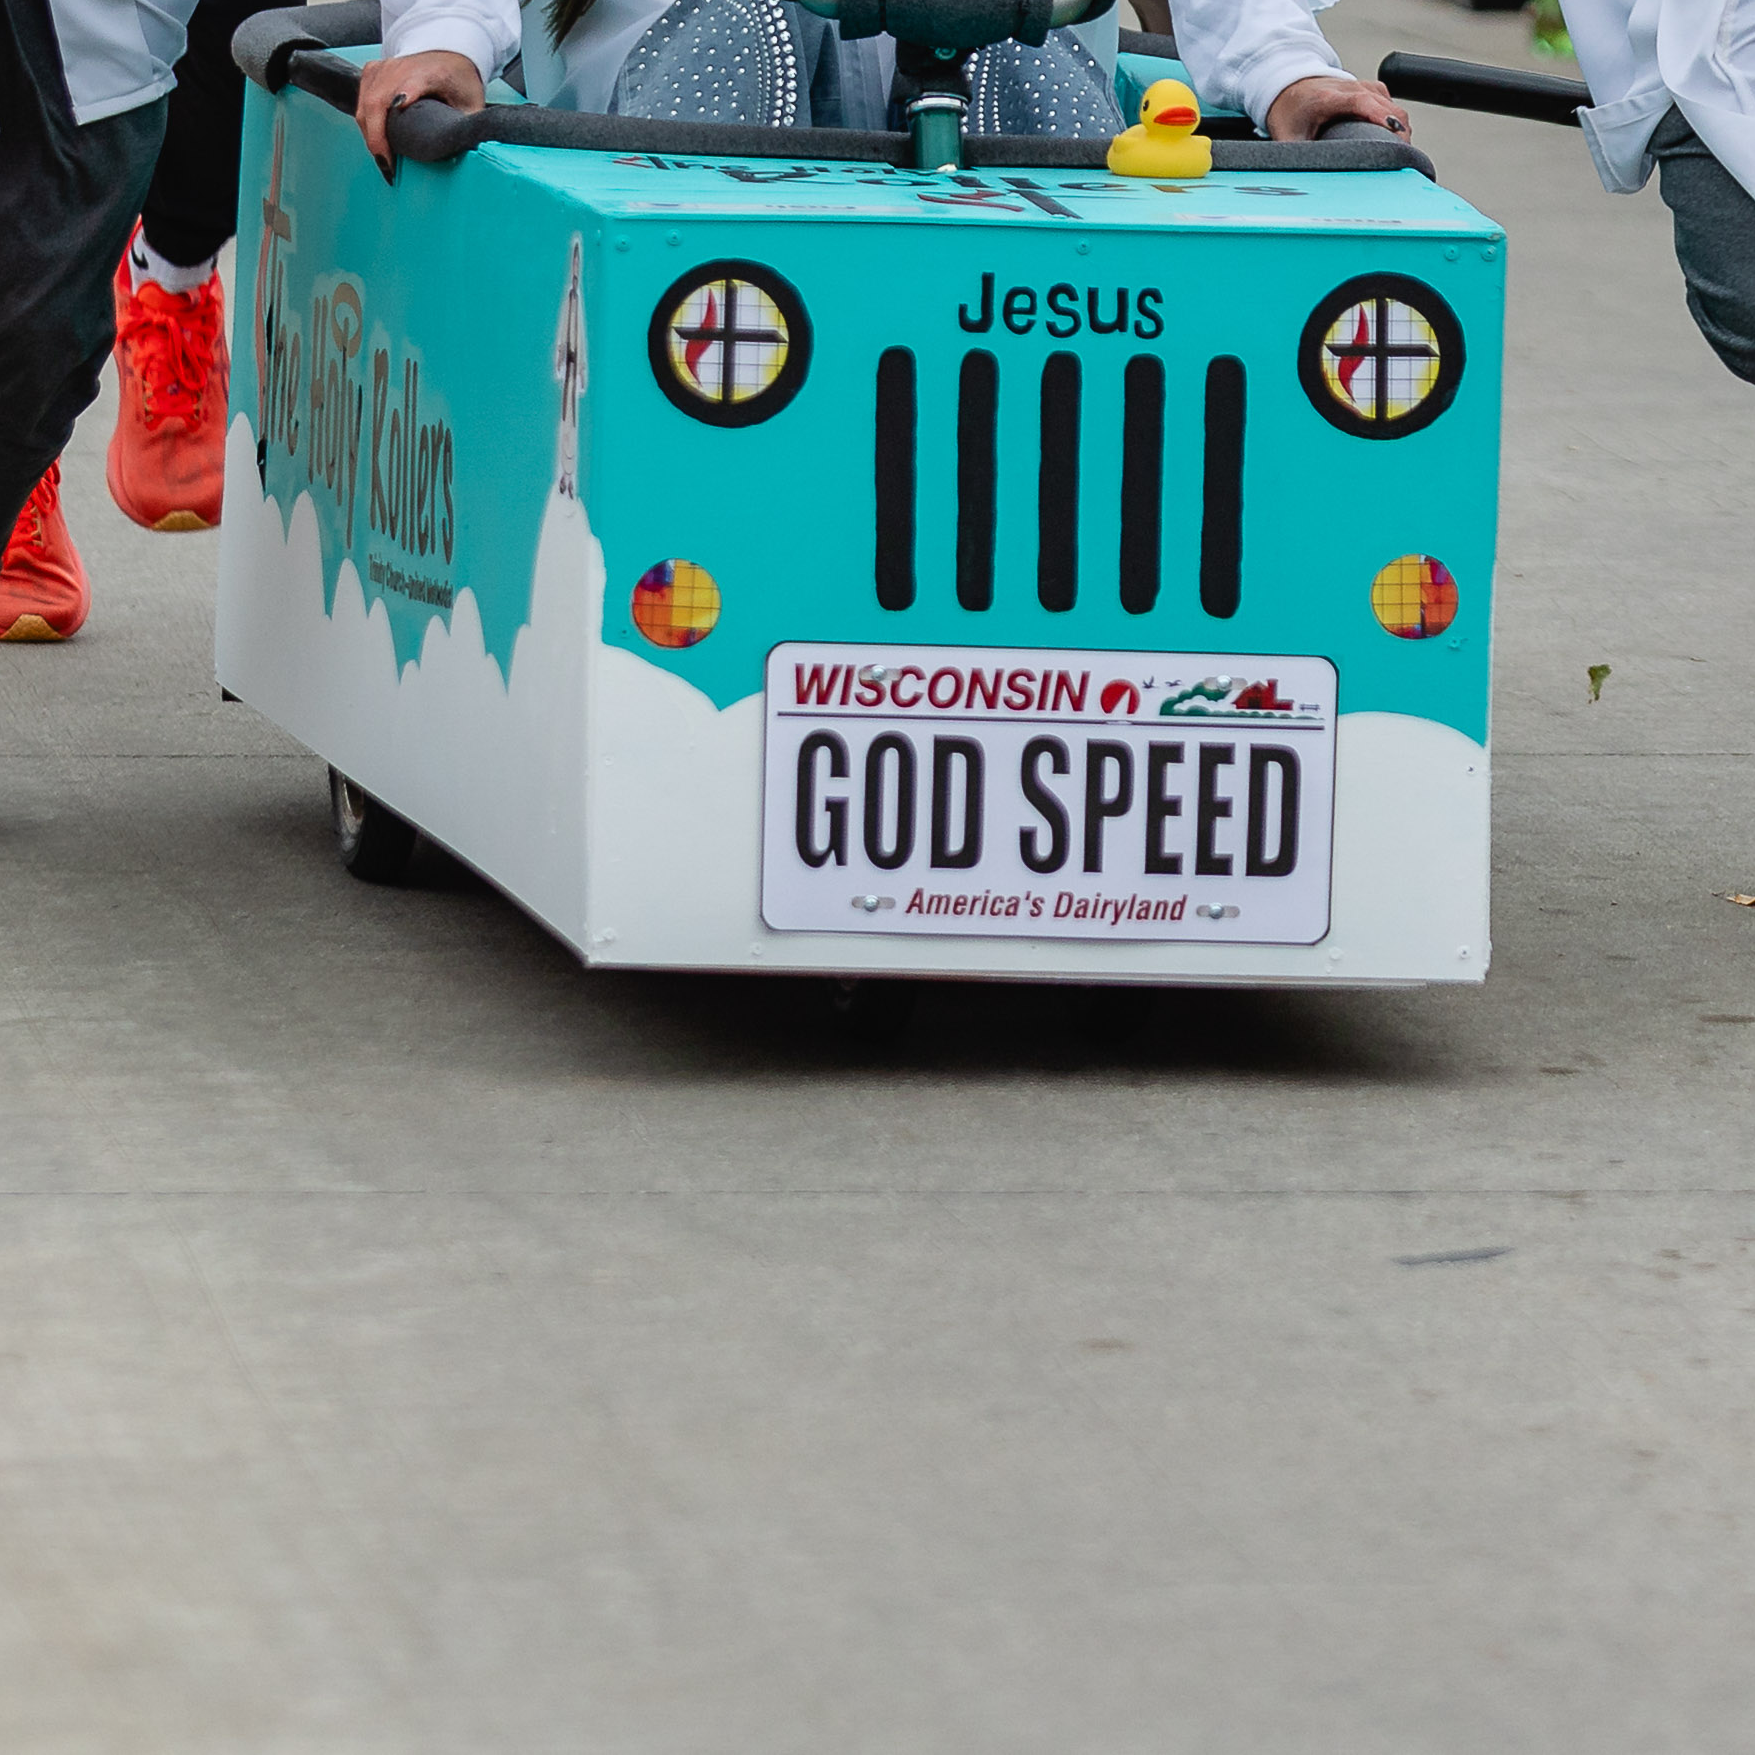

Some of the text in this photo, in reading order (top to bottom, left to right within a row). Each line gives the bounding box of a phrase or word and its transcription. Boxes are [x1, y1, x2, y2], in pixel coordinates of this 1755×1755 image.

[958, 272, 1165, 340] Jesus
[309, 286, 363, 550] Holy
[369, 348, 454, 565] Rollers
[793, 662, 1092, 713] WISCONSIN
[794, 727, 1303, 878] GOD SPEED
[905, 887, 1188, 927] America's Dairyland
